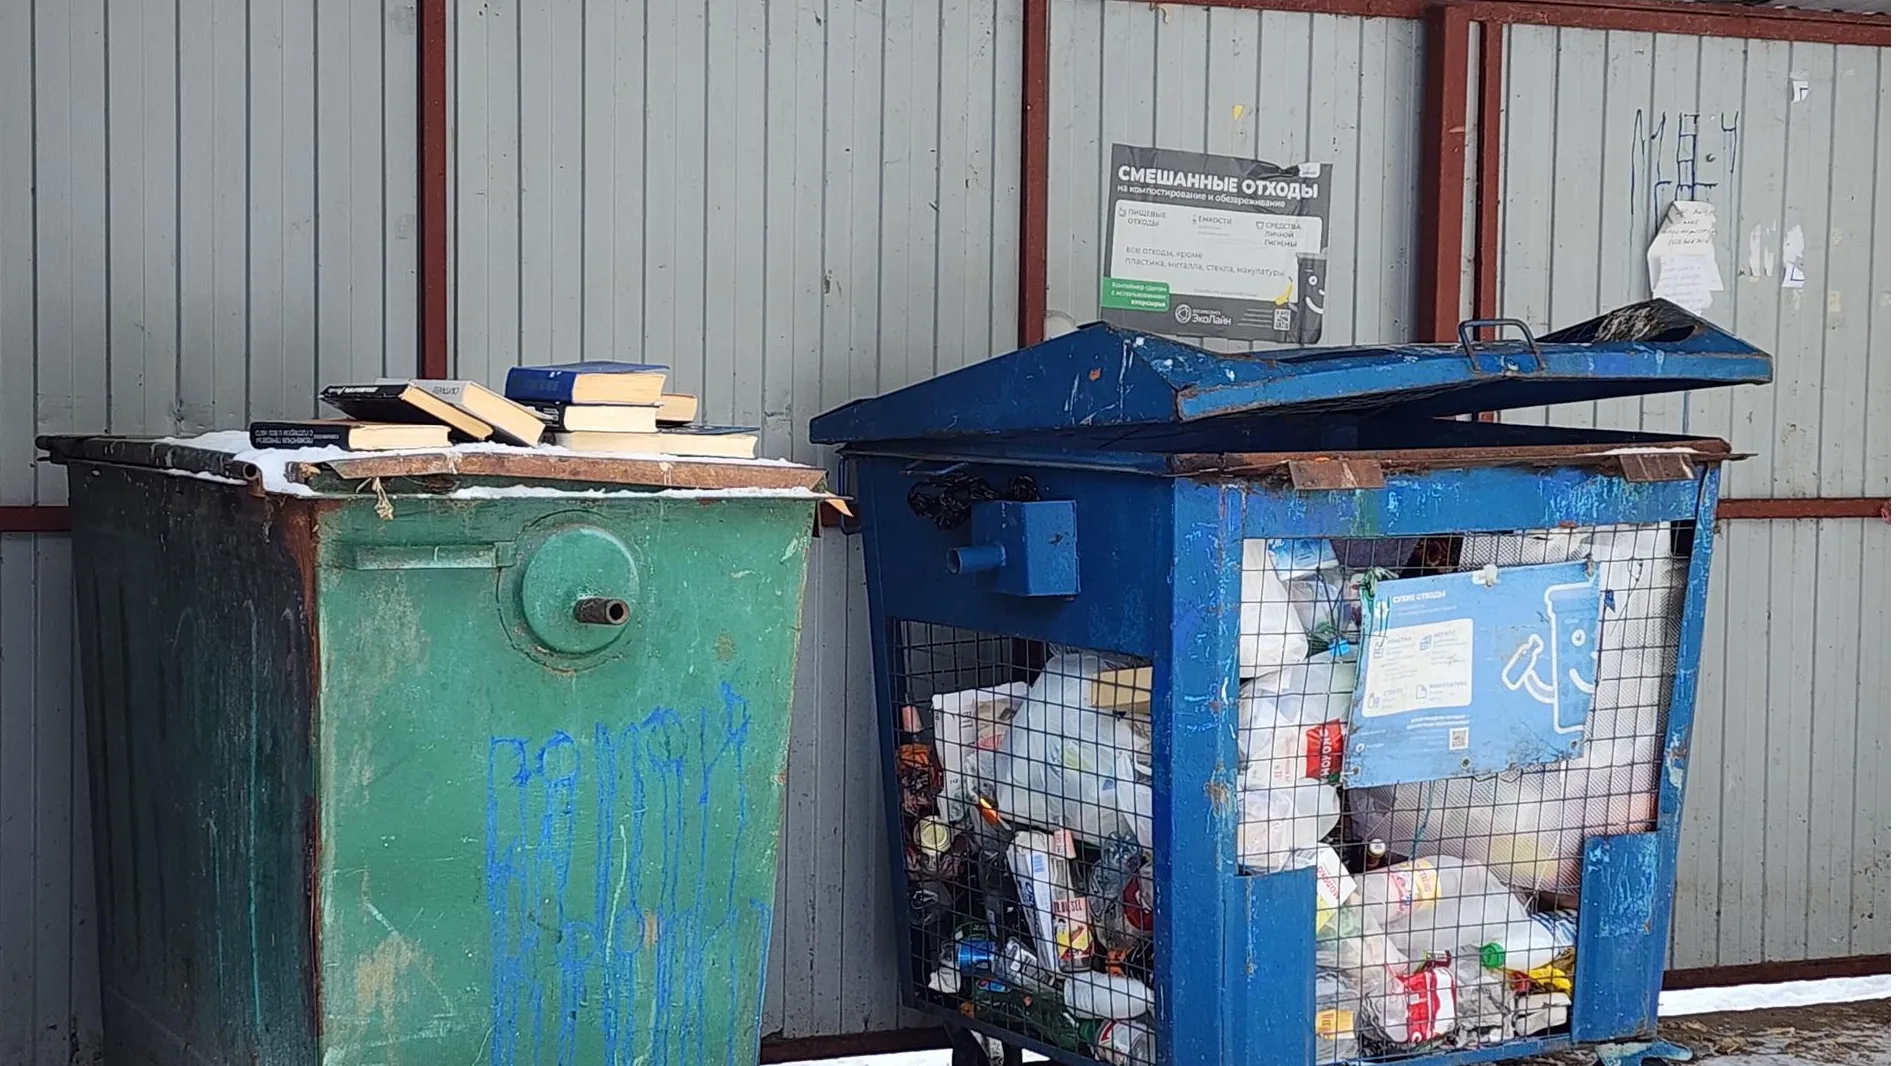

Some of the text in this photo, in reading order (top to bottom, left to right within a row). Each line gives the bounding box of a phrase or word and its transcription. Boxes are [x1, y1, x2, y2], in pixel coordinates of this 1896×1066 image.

[1118, 165, 1319, 200] СМЕШАННЫЕ ОТХОДЫ
[1117, 184, 1128, 194] на
[1129, 186, 1206, 201] компостирование
[1215, 193, 1286, 209] обезвреживание
[1128, 208, 1166, 218] ПИЩЕВЫЕ
[1127, 218, 1160, 226] ОТХОДЫ
[1265, 222, 1301, 230] СРЕДСТВА
[1264, 239, 1298, 247] ГИГИЕНЫ
[1192, 313, 1232, 325] ЭкоЛайн
